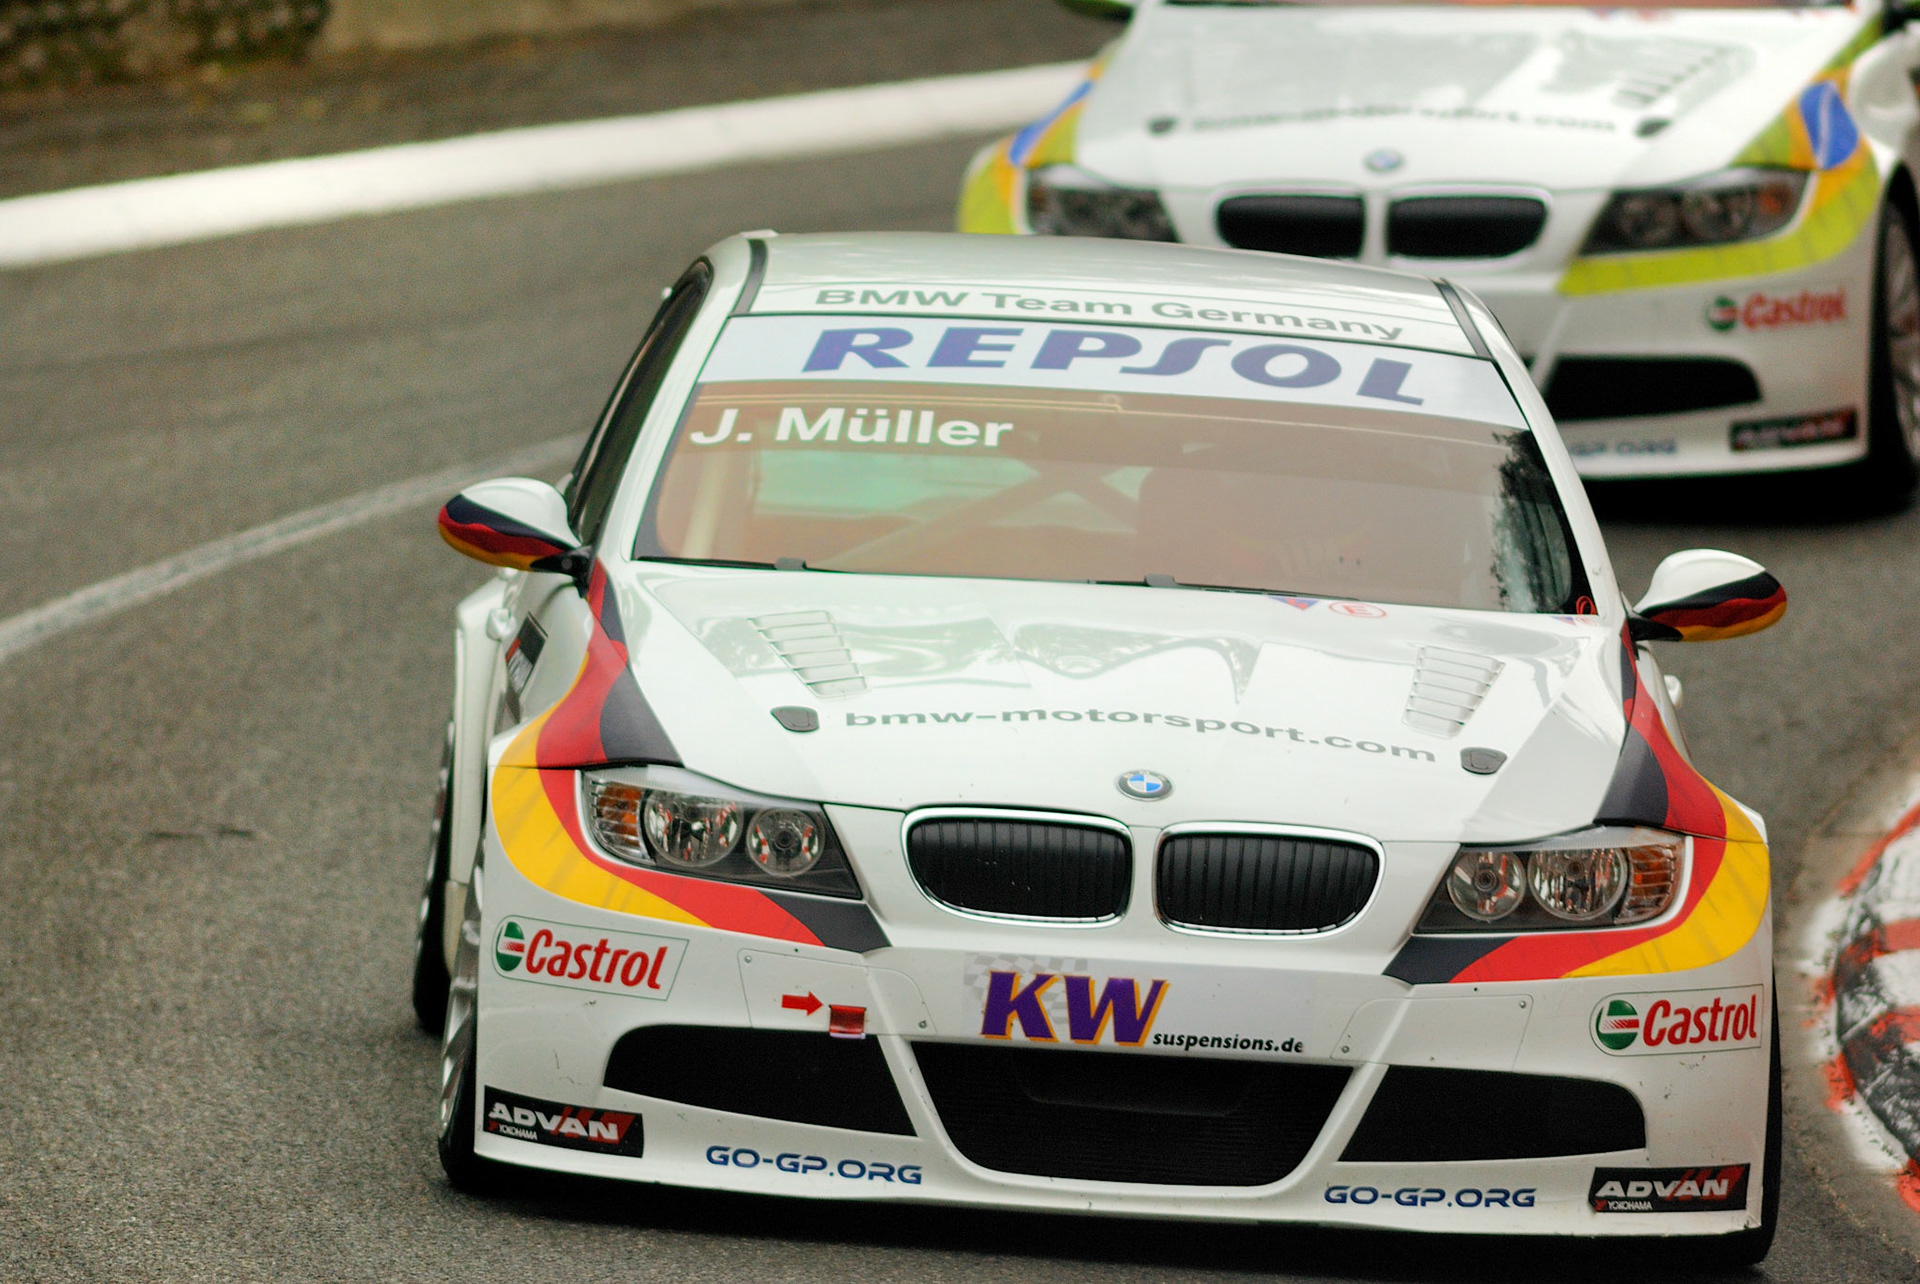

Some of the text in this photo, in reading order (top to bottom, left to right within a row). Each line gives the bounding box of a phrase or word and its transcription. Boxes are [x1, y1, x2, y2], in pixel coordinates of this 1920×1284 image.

[815, 289, 1404, 341] BMW Team Germany
[802, 326, 1426, 406] REPSOL
[688, 405, 1014, 447] J. Müller
[845, 708, 1437, 763] bmw-motorsport.com
[526, 929, 668, 990] Castrol
[980, 970, 1170, 1047] KW
[1643, 994, 1757, 1047] Castrol
[1153, 1031, 1304, 1054] suspensions.de
[489, 1102, 619, 1140] ADVAN
[706, 1145, 923, 1186] GO-GP.ORG
[1595, 1178, 1729, 1198] ADVAN
[1324, 1185, 1537, 1209] GO-GP.ORG
